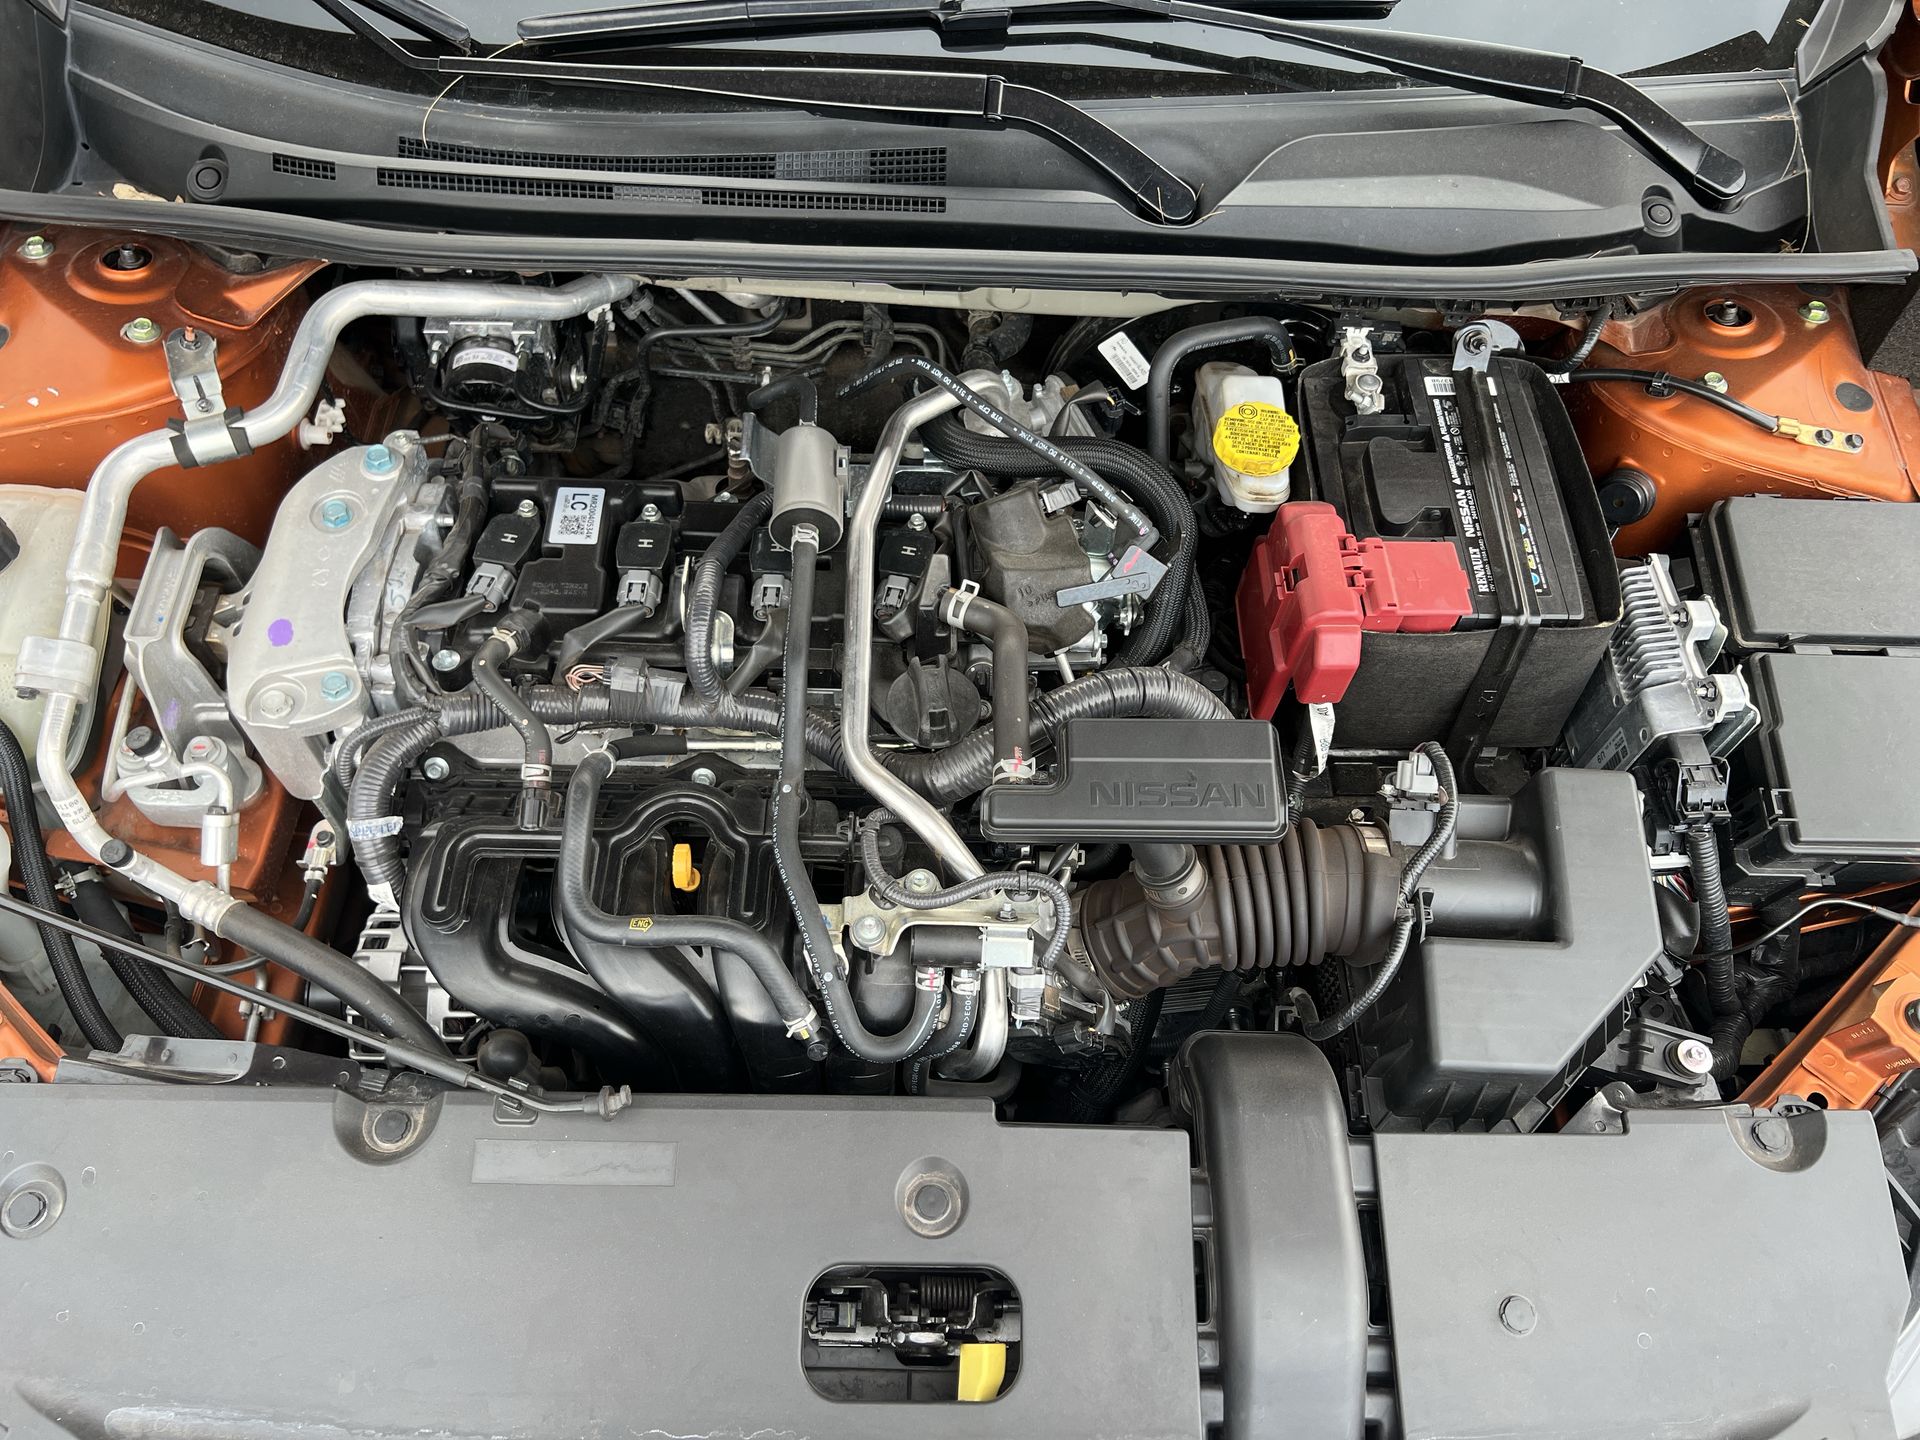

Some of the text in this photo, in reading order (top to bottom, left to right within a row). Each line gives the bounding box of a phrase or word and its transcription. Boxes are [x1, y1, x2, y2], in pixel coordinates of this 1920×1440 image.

[1455, 489, 1476, 538] NISSAN
[1469, 546, 1489, 592] RENAULT
[1090, 781, 1267, 809] NISSAN
[632, 919, 650, 928] ENG
